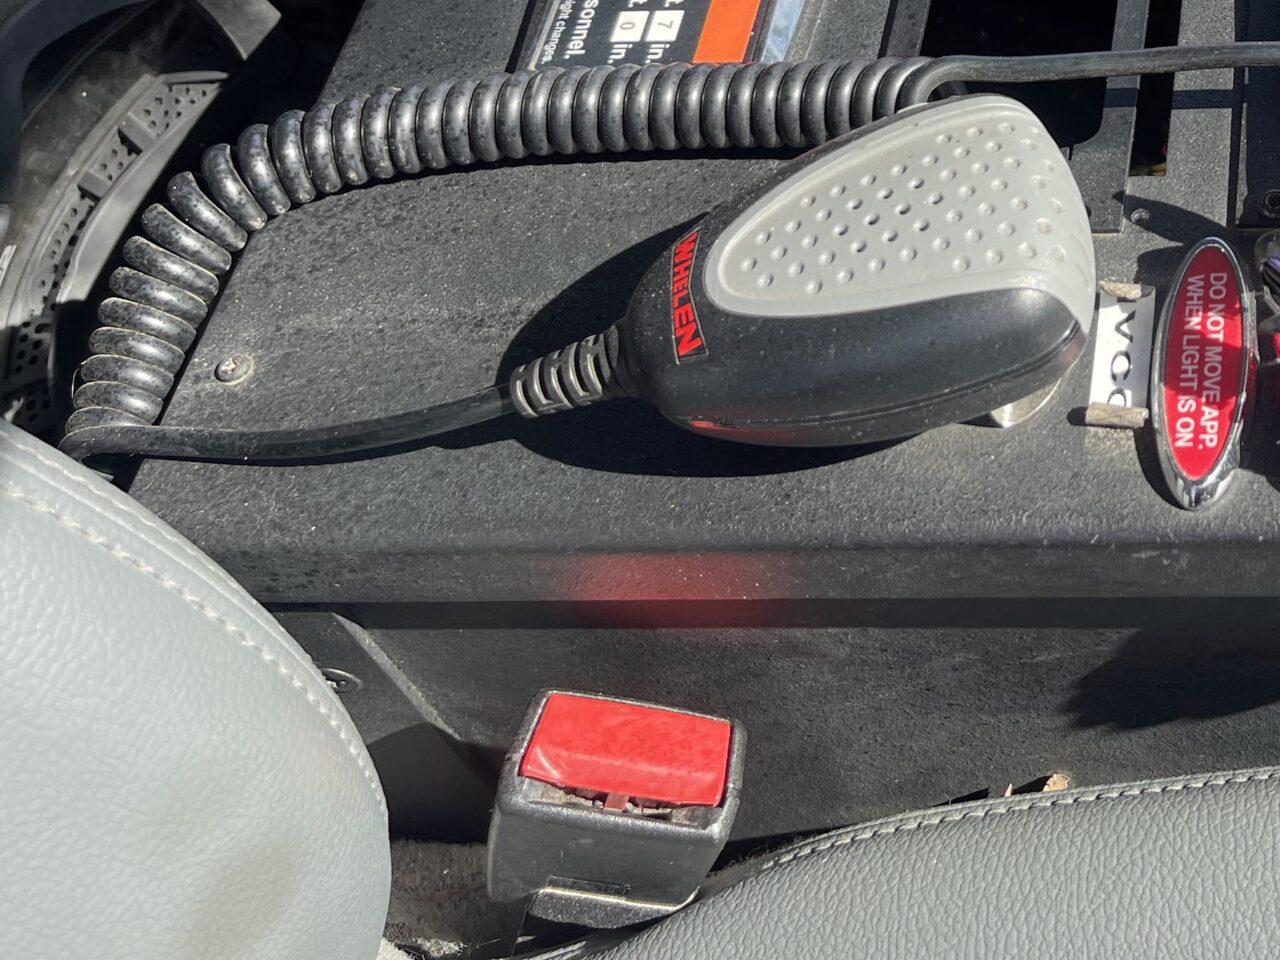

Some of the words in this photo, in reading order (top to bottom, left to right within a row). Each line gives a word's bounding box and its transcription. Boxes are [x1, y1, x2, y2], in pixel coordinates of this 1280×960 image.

[619, 21, 635, 30] 0
[657, 18, 674, 29] 7
[541, 20, 566, 64] changes.
[607, 43, 632, 64] in.
[645, 43, 670, 63] in.
[672, 230, 703, 357] WHELEN
[1184, 274, 1206, 330] WHEN
[1208, 272, 1228, 300] DO
[1206, 303, 1225, 342] NOT
[1179, 335, 1201, 394] LIGHT
[1202, 346, 1223, 403] MOVE
[1177, 395, 1197, 413] IS
[1175, 418, 1195, 448] ON
[1198, 406, 1219, 450] APP.
